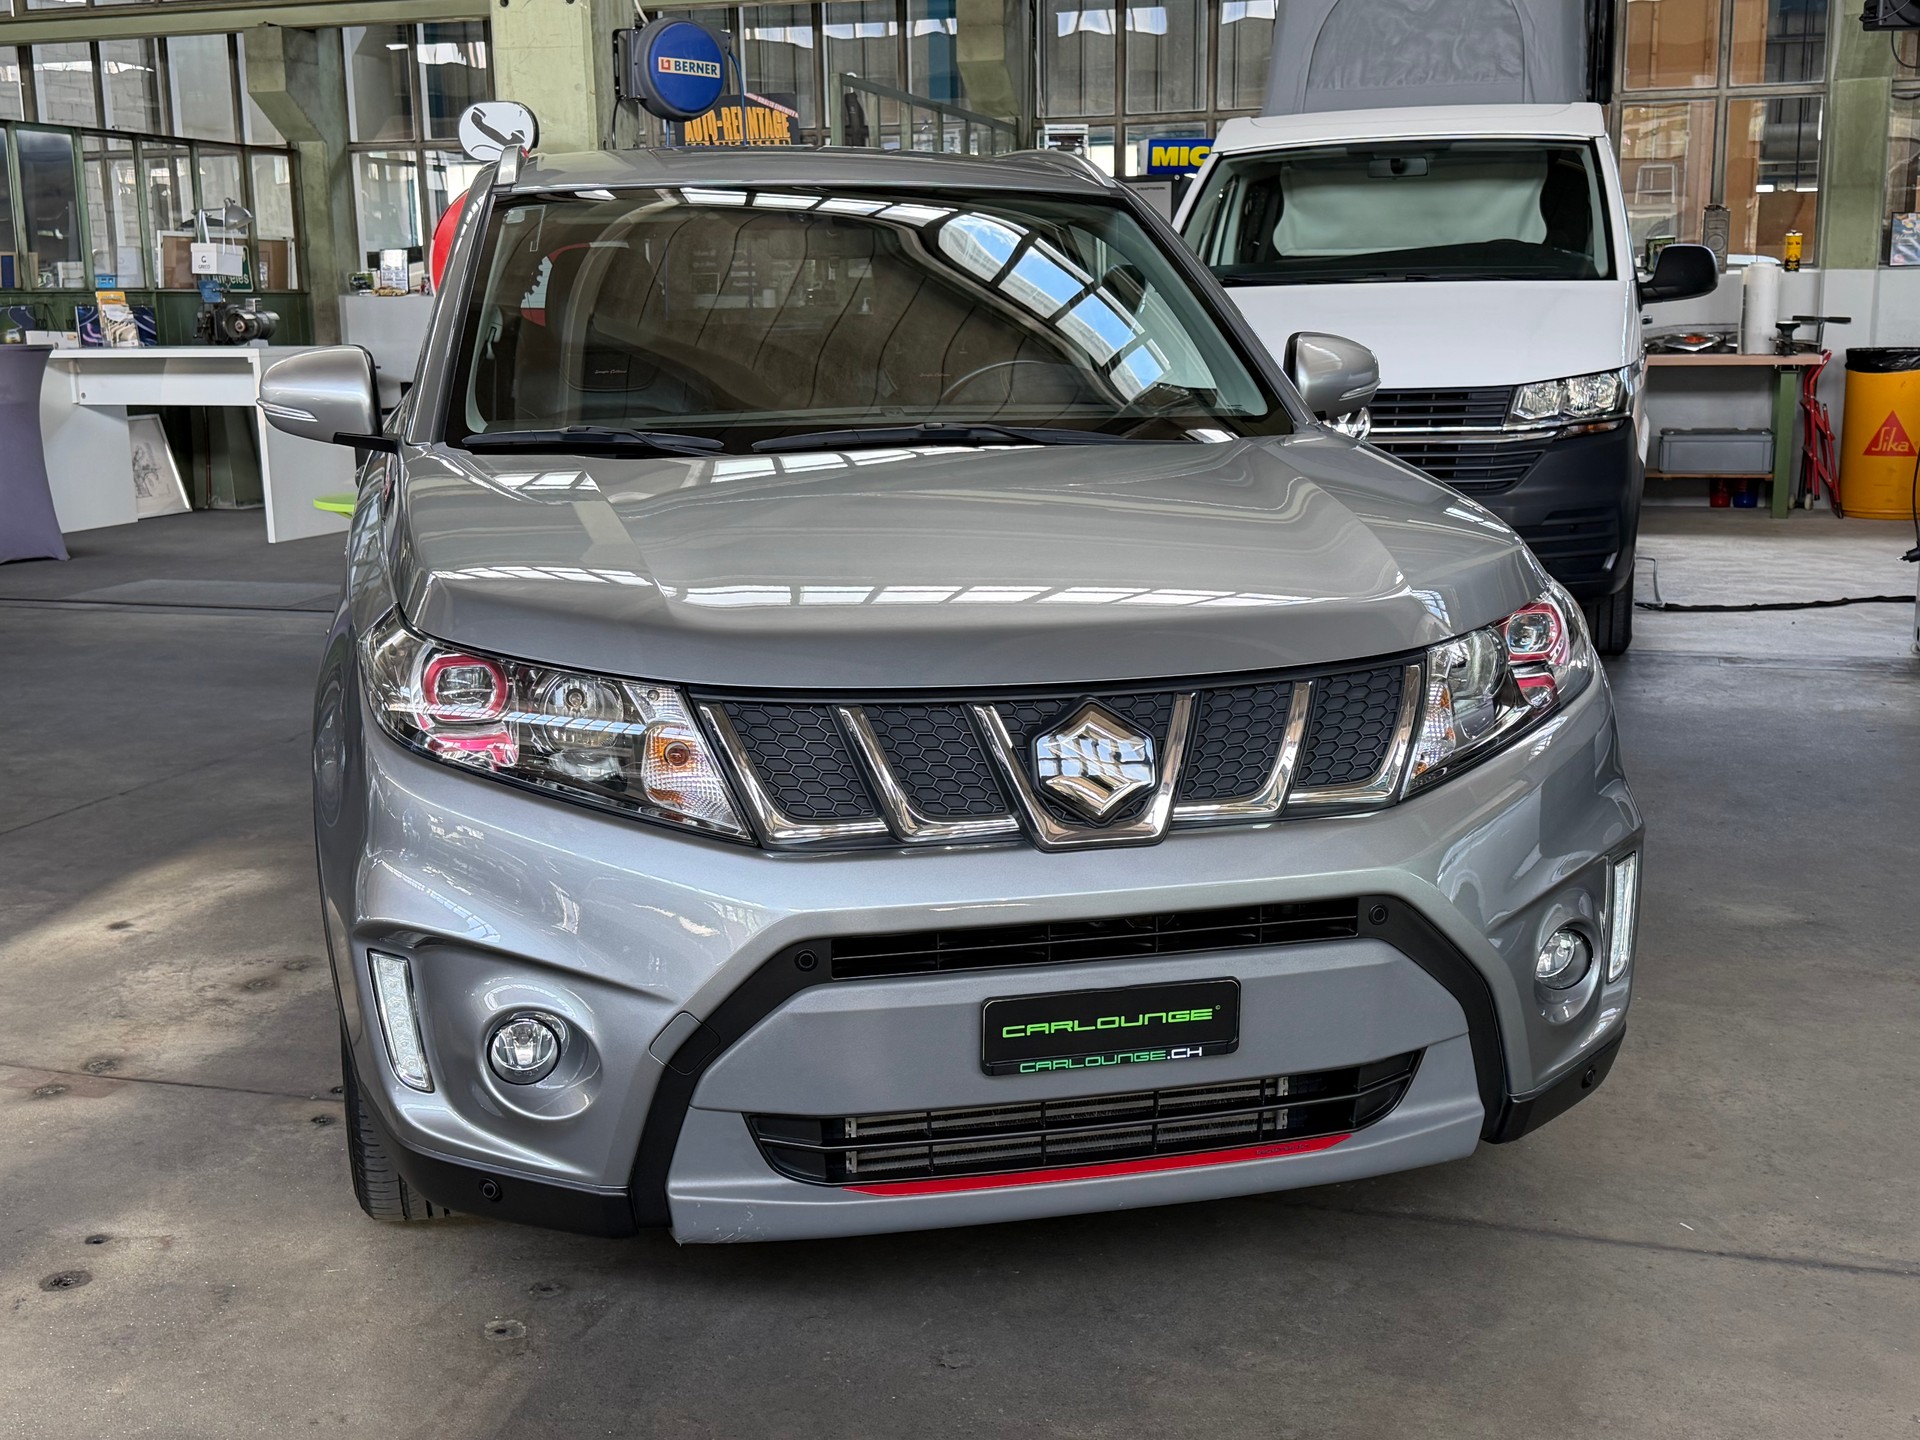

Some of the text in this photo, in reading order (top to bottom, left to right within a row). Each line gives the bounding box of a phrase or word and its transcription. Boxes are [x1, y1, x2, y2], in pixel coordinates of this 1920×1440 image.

[674, 60, 718, 76] BERNER
[1871, 426, 1910, 452] Sika
[1002, 1007, 1214, 1039] CARLOUNGE
[1019, 1046, 1203, 1074] CARLOUNGE.CH
